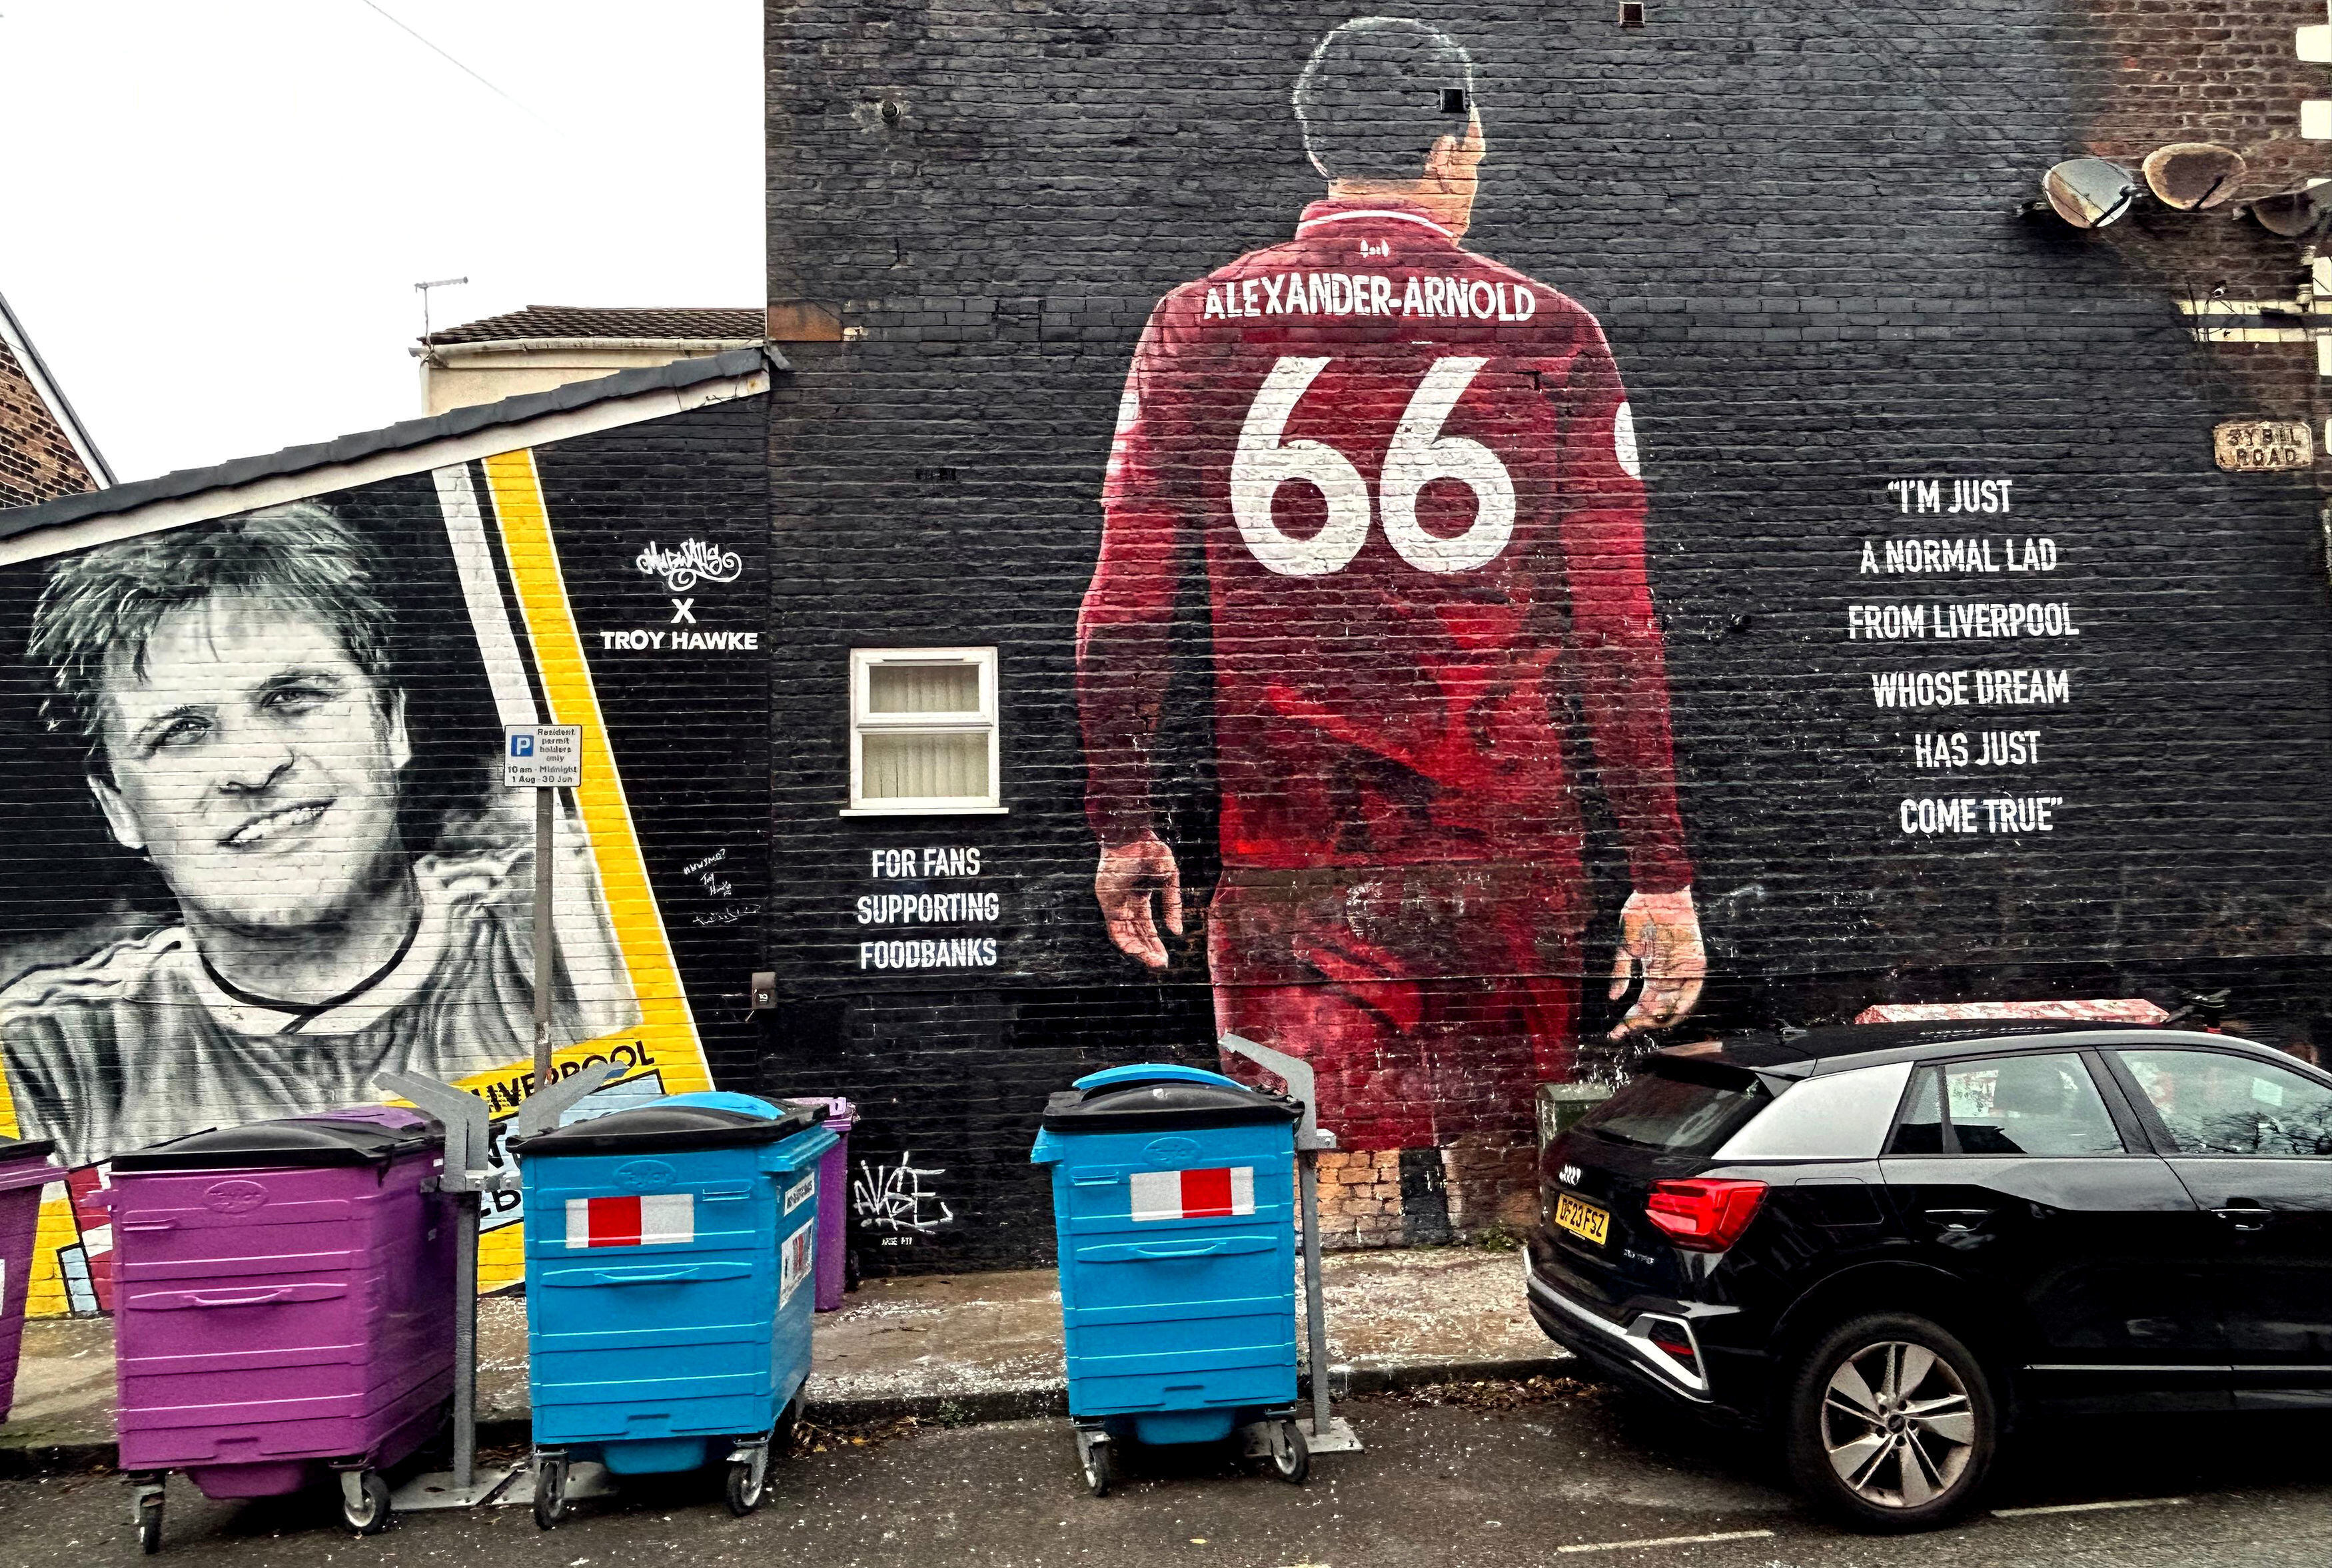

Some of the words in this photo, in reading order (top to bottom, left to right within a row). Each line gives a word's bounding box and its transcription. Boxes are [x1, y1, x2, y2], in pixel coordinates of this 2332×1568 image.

[1203, 272, 1535, 322] ALEXANDER-ARNOLD
[1231, 356, 1516, 575] 66
[2237, 448, 2297, 466] ROAD
[1947, 480, 2012, 513] JUST
[1860, 540, 1879, 574] A
[1885, 539, 2001, 573] NORMAL
[2006, 538, 2057, 572] LAD
[670, 598, 697, 624] X
[1848, 604, 1925, 639] FROM
[1933, 603, 2080, 638] LIVERPOOL
[600, 630, 665, 651] TROY
[672, 631, 758, 651] HAWKE
[1872, 671, 1970, 708] WHOSE
[1976, 669, 2070, 705] DREAM
[516, 737, 530, 755] P
[1915, 732, 1969, 767] HAS
[1975, 730, 2041, 766] JUST
[1900, 799, 1978, 835] COME
[872, 849, 916, 878] FOR
[923, 847, 981, 877] FANS
[857, 892, 999, 924] SUPPORTING
[860, 938, 997, 969] FOODBANKS
[1583, 1208, 1605, 1238] FSZ
